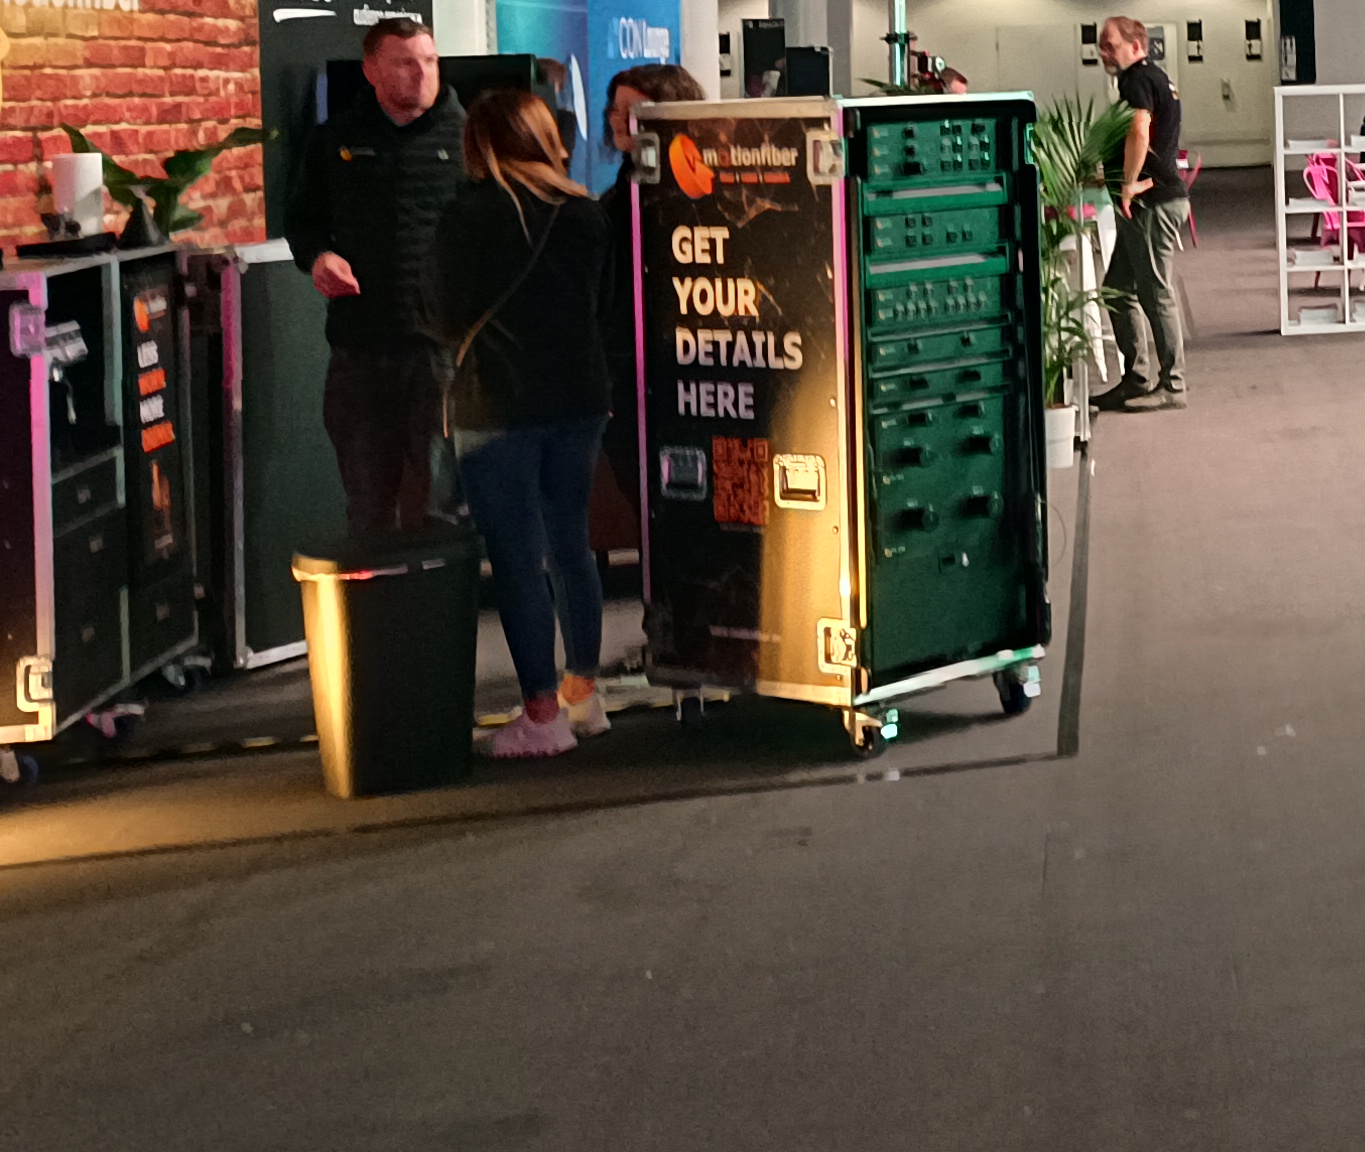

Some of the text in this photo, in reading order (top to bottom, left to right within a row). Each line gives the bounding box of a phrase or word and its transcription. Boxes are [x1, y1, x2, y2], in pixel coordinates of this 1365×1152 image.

[671, 225, 730, 265] GET
[672, 276, 760, 317] YOUR
[675, 326, 804, 371] DETAILS
[676, 379, 755, 421] HERE
